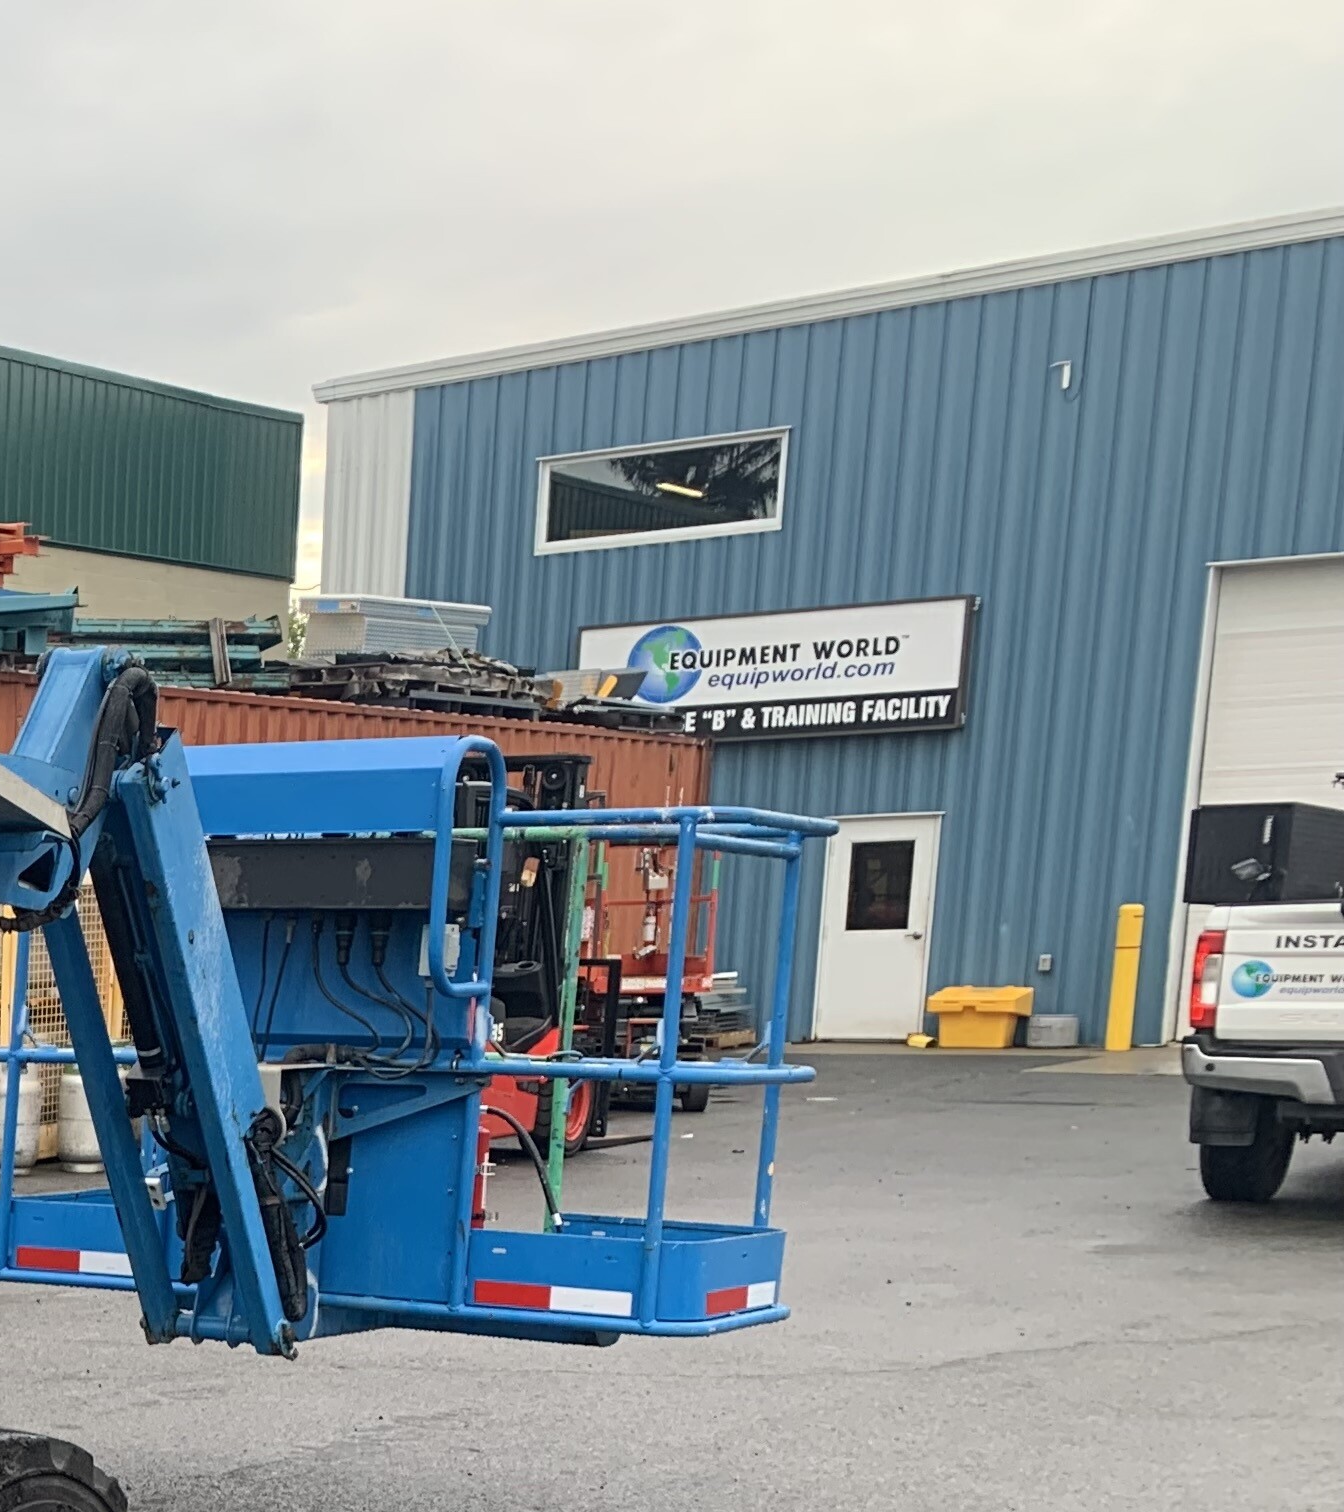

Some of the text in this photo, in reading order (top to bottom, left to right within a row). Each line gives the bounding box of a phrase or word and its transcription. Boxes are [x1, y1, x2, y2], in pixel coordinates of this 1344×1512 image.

[669, 642, 801, 671] EQUIPMENT
[707, 658, 895, 690] equipworld.com
[741, 709, 756, 730] &
[761, 699, 856, 728] TRAINING
[862, 694, 951, 722] FACILITY
[1255, 973, 1344, 983] EQUIPMENT W
